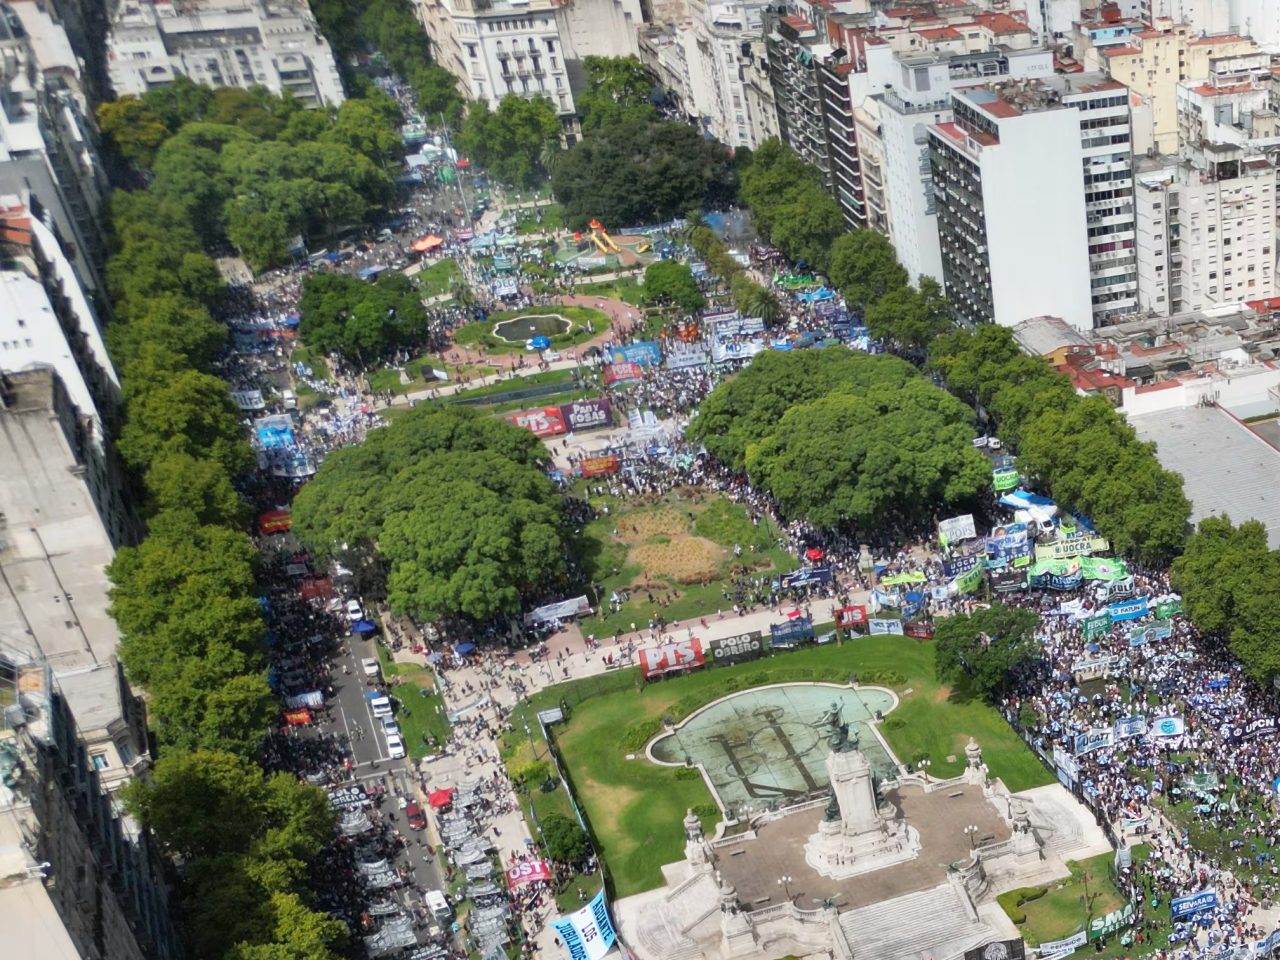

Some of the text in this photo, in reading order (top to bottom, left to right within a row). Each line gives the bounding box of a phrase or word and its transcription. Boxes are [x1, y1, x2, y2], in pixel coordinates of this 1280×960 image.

[516, 413, 549, 431] PTS
[569, 411, 606, 423] ROSAS
[1063, 543, 1092, 553] UOCRA
[841, 610, 862, 625] JIS
[714, 640, 760, 658] OBRERO
[720, 634, 750, 649] POLO
[649, 641, 695, 670] PTS
[1245, 718, 1275, 733] UPCN
[593, 897, 613, 941] AGUANTE
[581, 921, 597, 942] LOS
